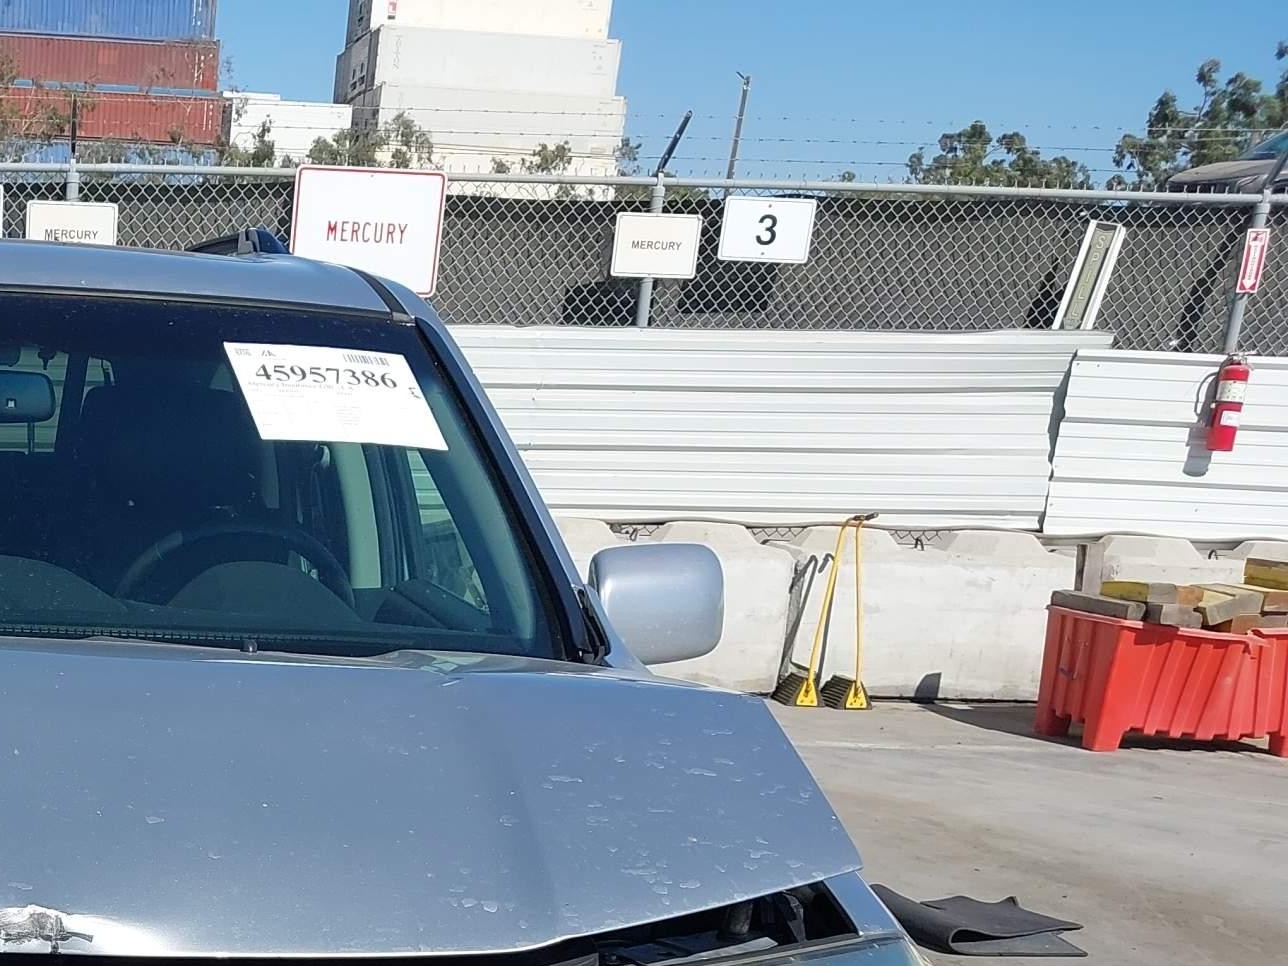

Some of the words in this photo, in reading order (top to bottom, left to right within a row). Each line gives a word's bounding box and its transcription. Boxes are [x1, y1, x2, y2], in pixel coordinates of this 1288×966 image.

[44, 228, 99, 241] MERCURY
[326, 219, 409, 245] MERCURY
[755, 214, 779, 246] 3
[631, 239, 683, 251] MERCURY
[255, 363, 398, 389] 45957386
